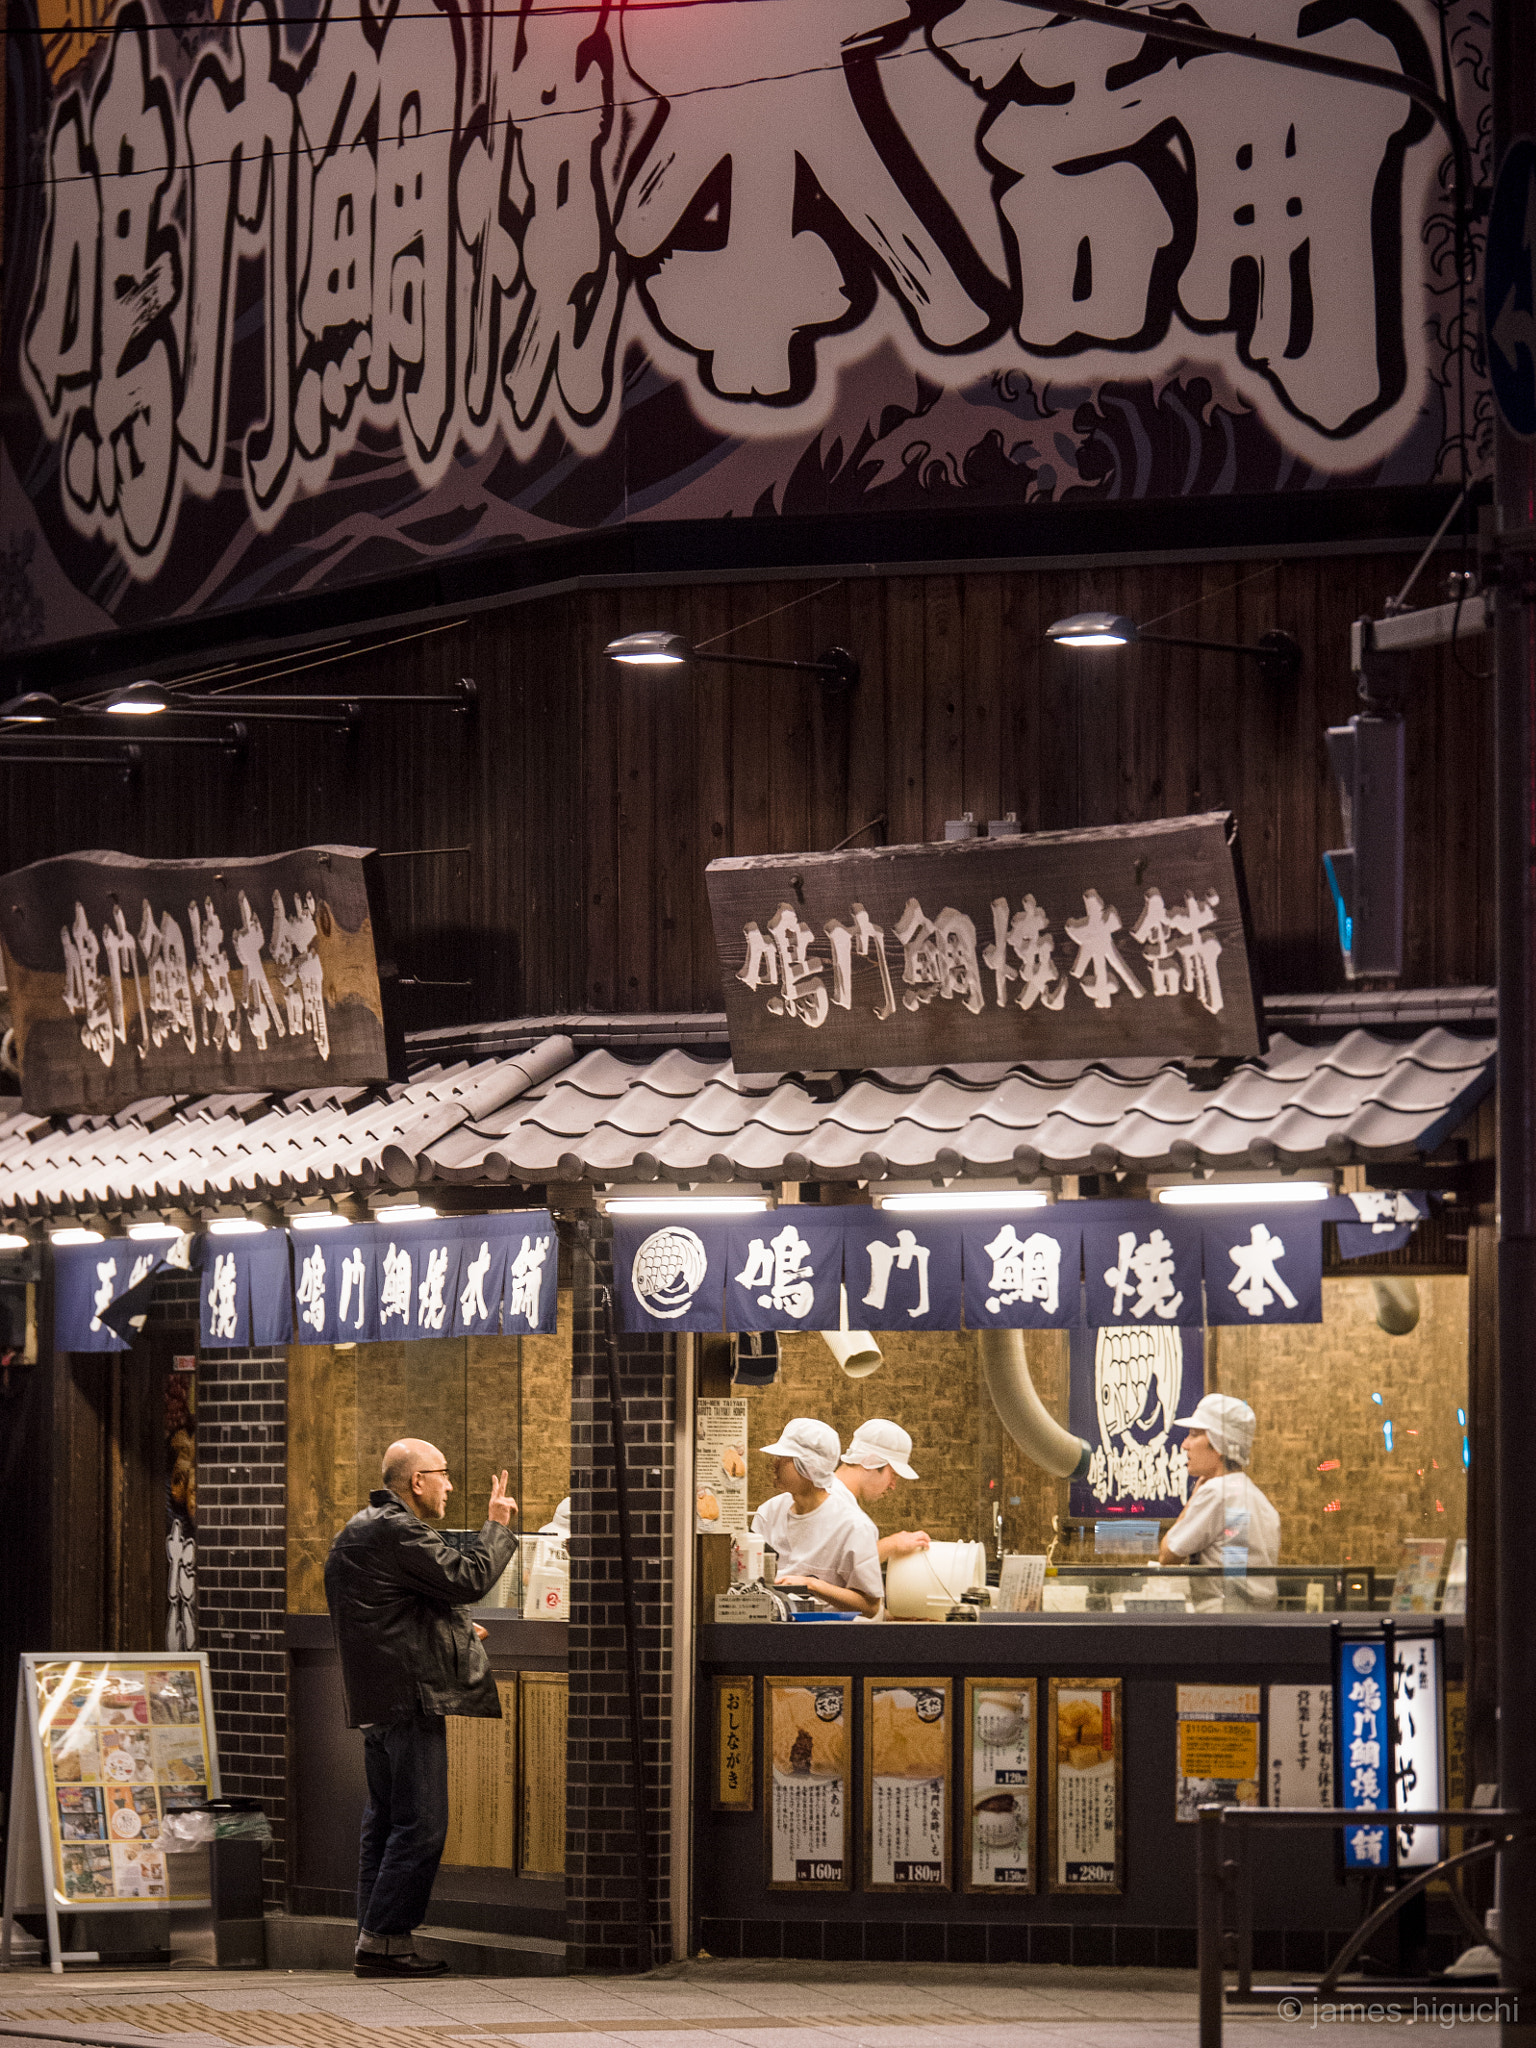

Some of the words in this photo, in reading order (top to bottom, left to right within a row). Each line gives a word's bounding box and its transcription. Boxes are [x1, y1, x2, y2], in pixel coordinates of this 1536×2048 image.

[62, 889, 330, 1068] 鳴門鯛焼本舗
[735, 887, 1224, 1028] 鳴門鯛焼本舗
[297, 1234, 551, 1333] 鳴門鯛焼本舗
[726, 1692, 740, 1790] おしながき
[809, 1863, 842, 1880] 160円
[907, 1864, 941, 1881] 180円
[1079, 1866, 1115, 1882] 280円
